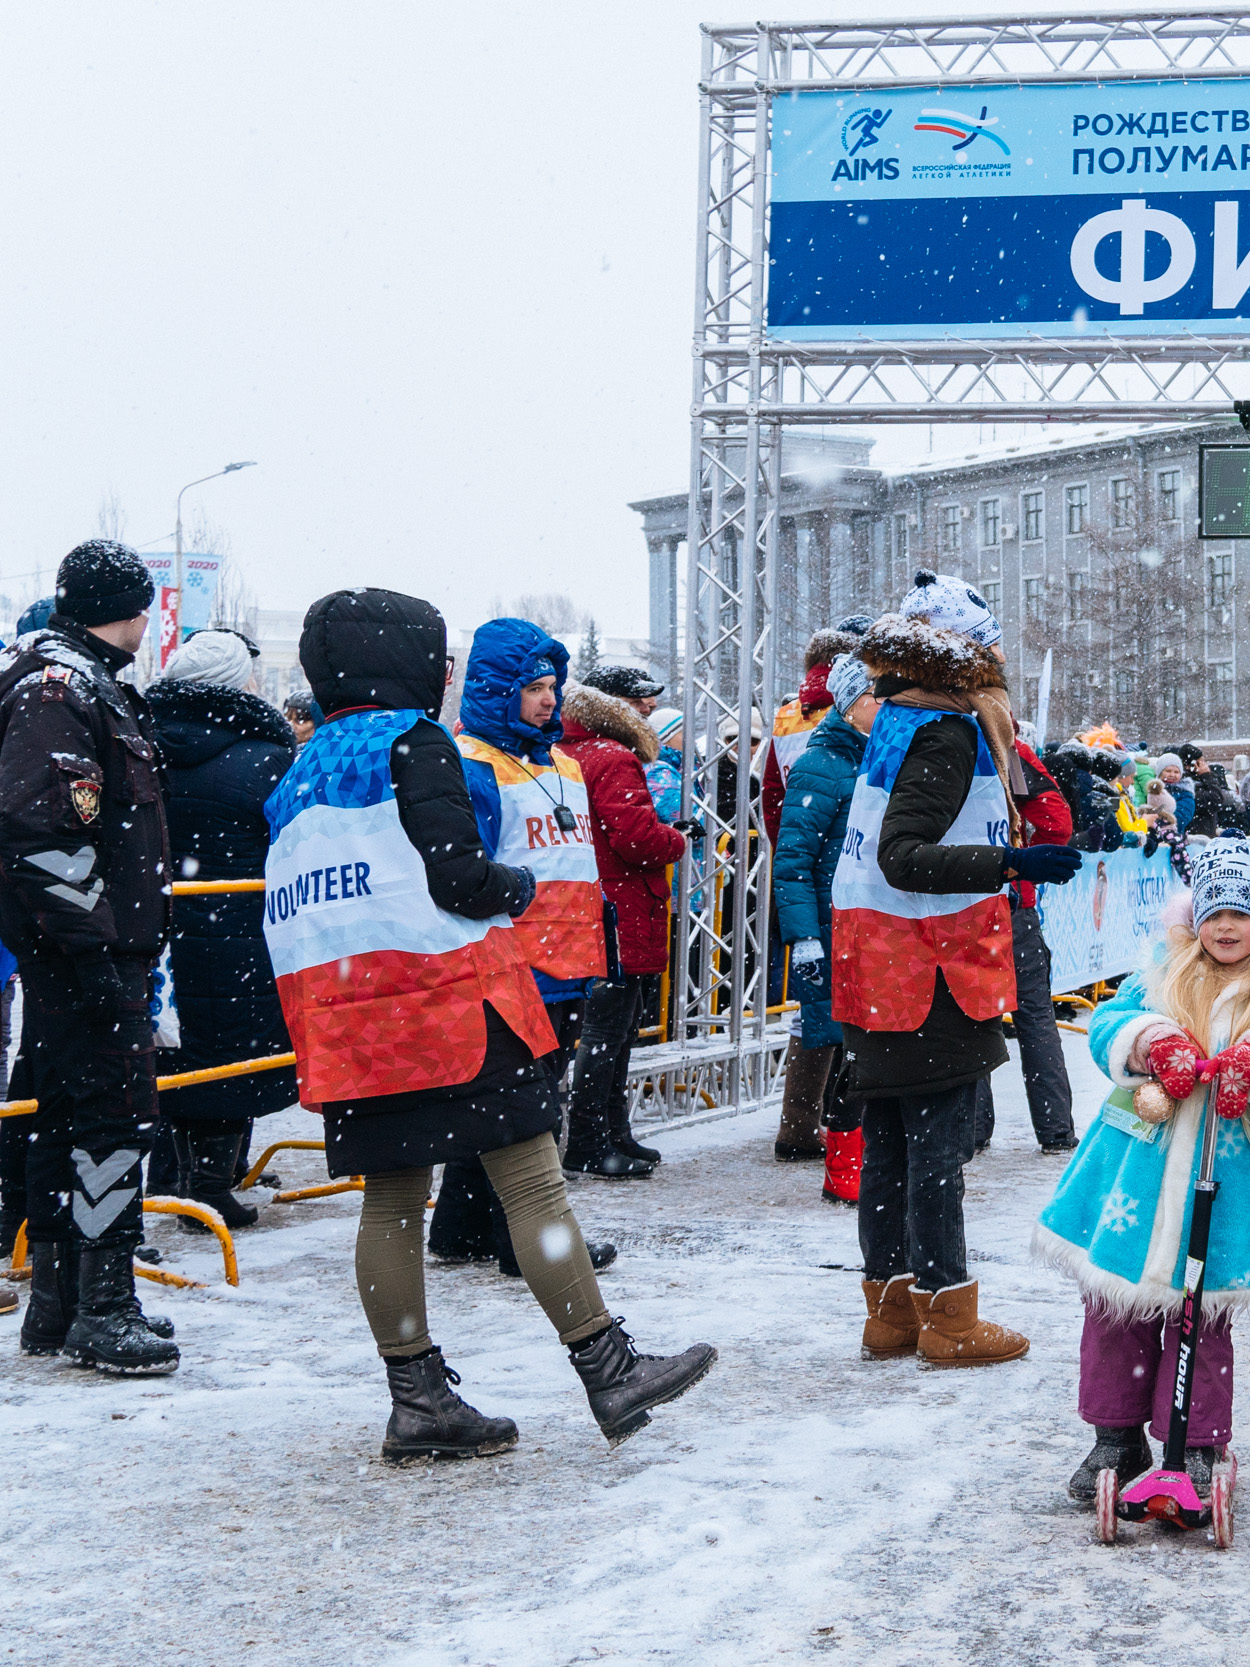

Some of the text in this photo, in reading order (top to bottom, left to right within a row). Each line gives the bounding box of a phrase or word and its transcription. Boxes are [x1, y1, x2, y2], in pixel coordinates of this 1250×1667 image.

[831, 157, 900, 182] AIMS
[912, 164, 972, 172] ВСЕРОССИЙСКАЯ
[912, 170, 1012, 180] ЛЕГКОЙ АТЛЕТИКИ
[145, 560, 172, 569] 020
[187, 560, 219, 571] 2020
[267, 861, 373, 925] VOLNTEER
